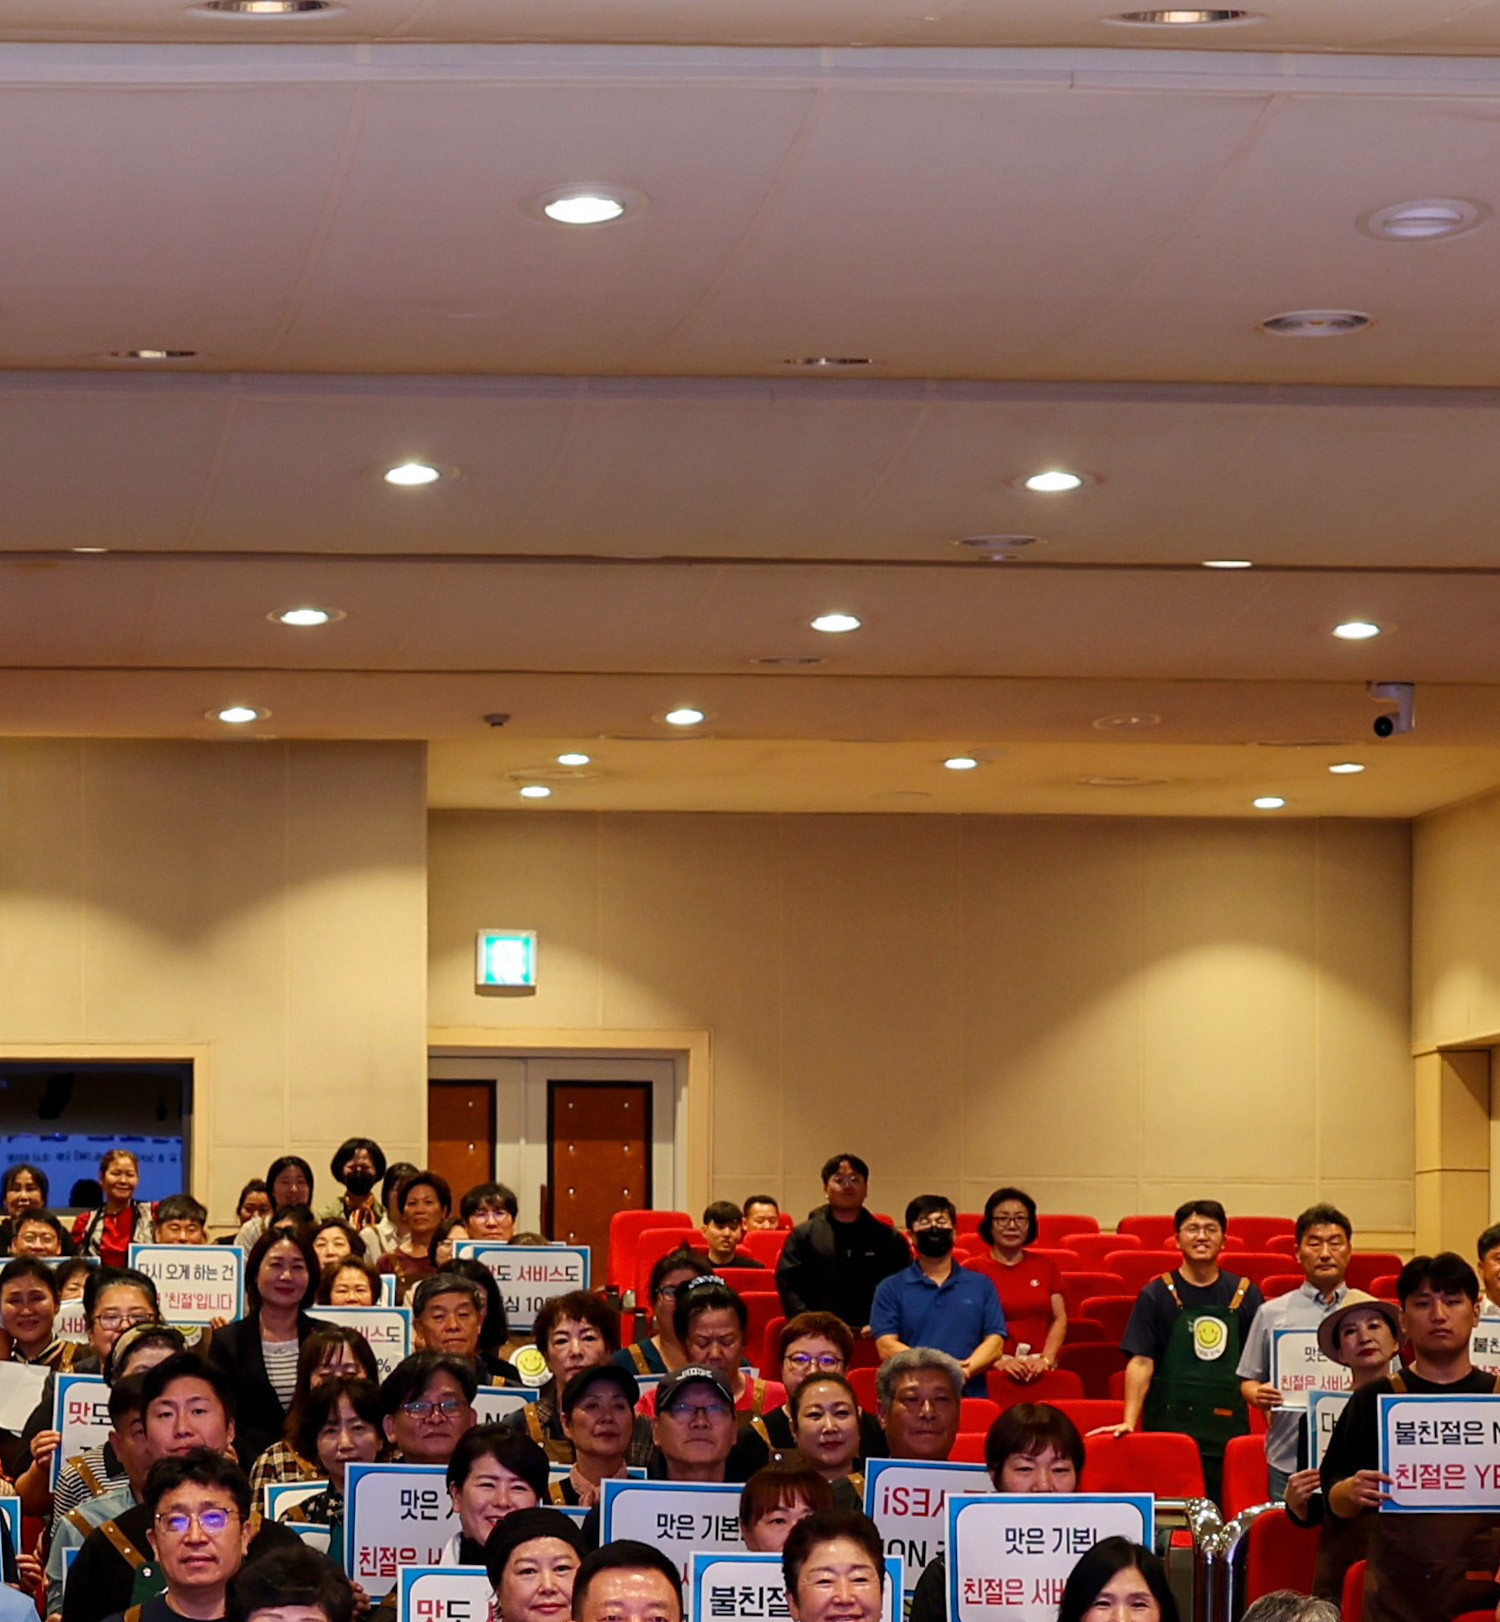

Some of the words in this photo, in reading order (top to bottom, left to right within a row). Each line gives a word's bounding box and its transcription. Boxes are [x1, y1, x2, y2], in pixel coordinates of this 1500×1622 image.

[166, 1264, 190, 1280] 오게
[194, 1264, 218, 1281] 하는
[222, 1265, 233, 1281] 건
[1395, 1421, 1484, 1445] 불친절은
[1396, 1464, 1466, 1489] 친절은
[657, 1514, 695, 1540] 맛은
[1005, 1528, 1045, 1554] 맛은
[964, 1578, 1024, 1605] 친절은
